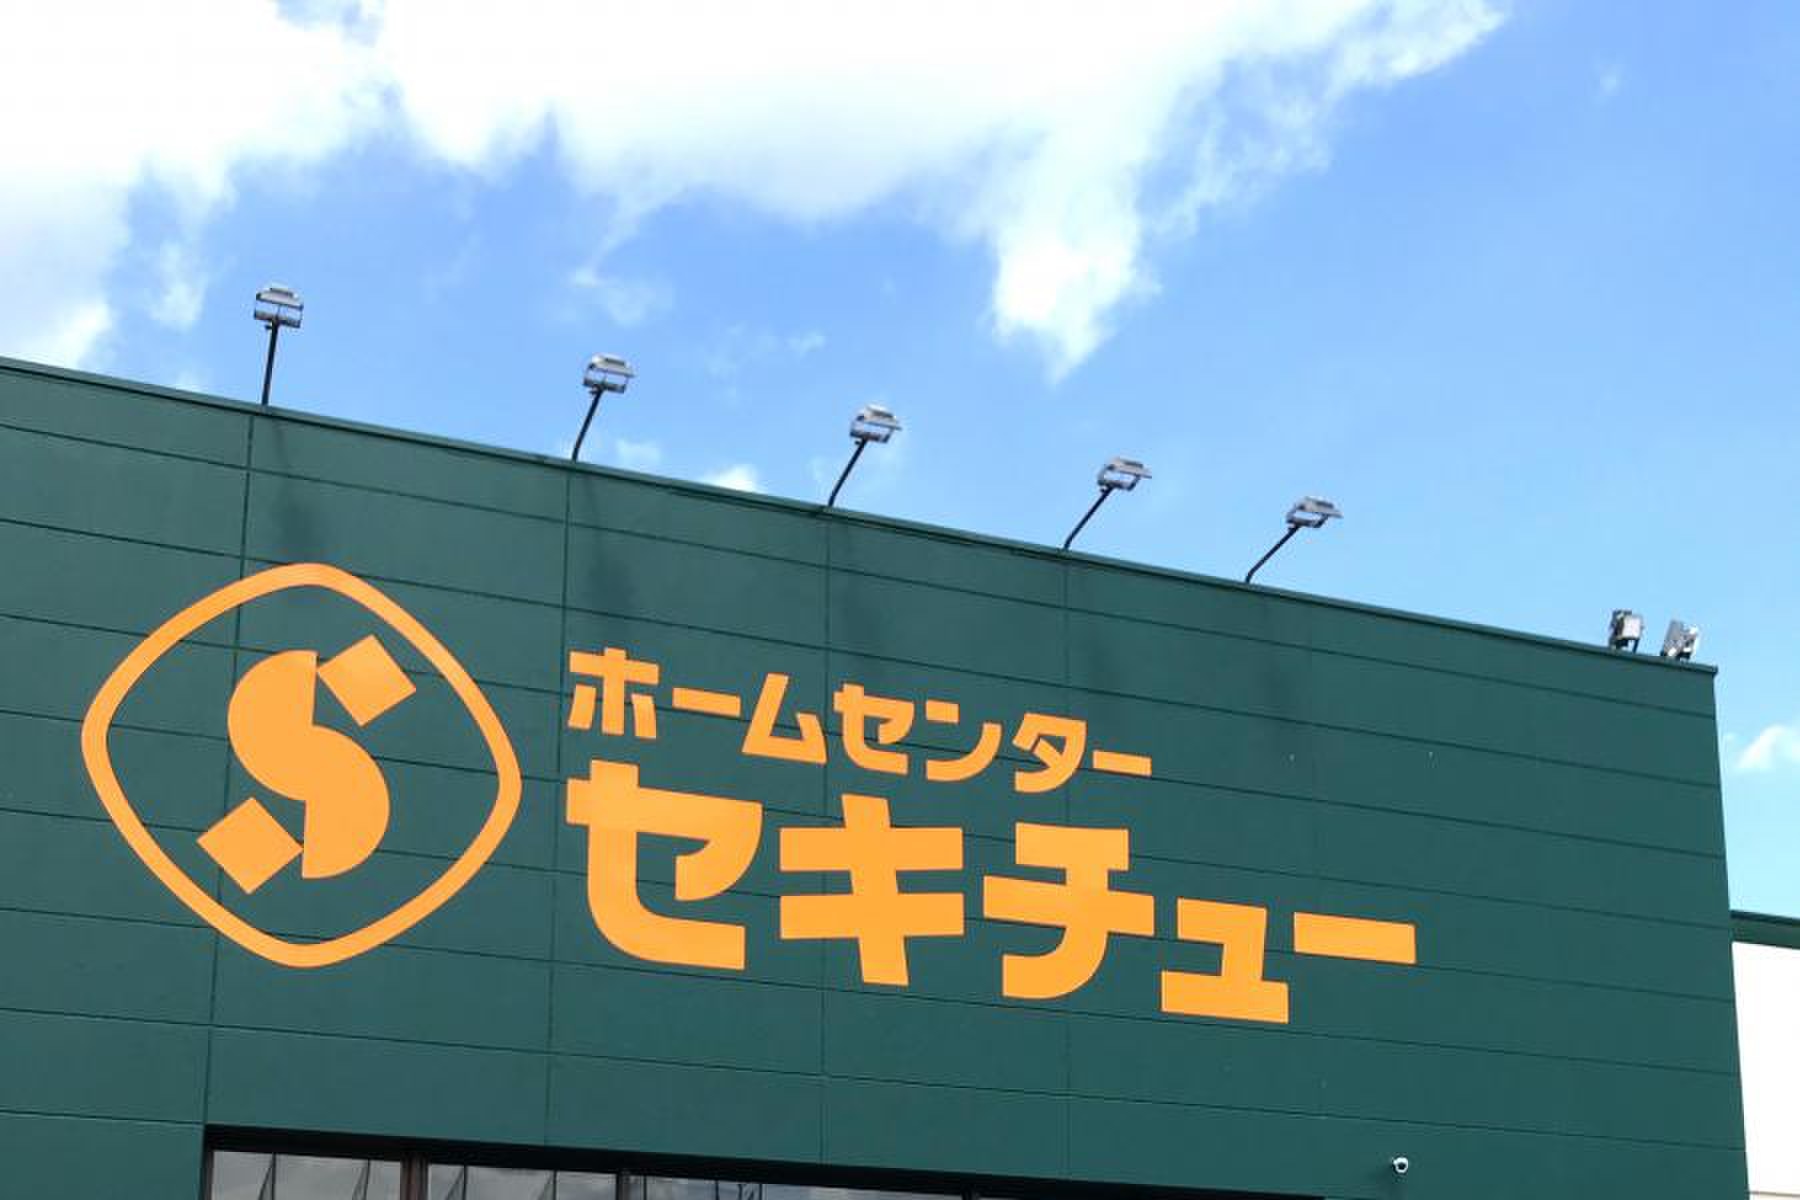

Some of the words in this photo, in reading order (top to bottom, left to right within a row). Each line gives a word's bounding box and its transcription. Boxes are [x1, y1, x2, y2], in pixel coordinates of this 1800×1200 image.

[567, 647, 1153, 794] ホームセンター
[566, 759, 1417, 1024] セキチュー
